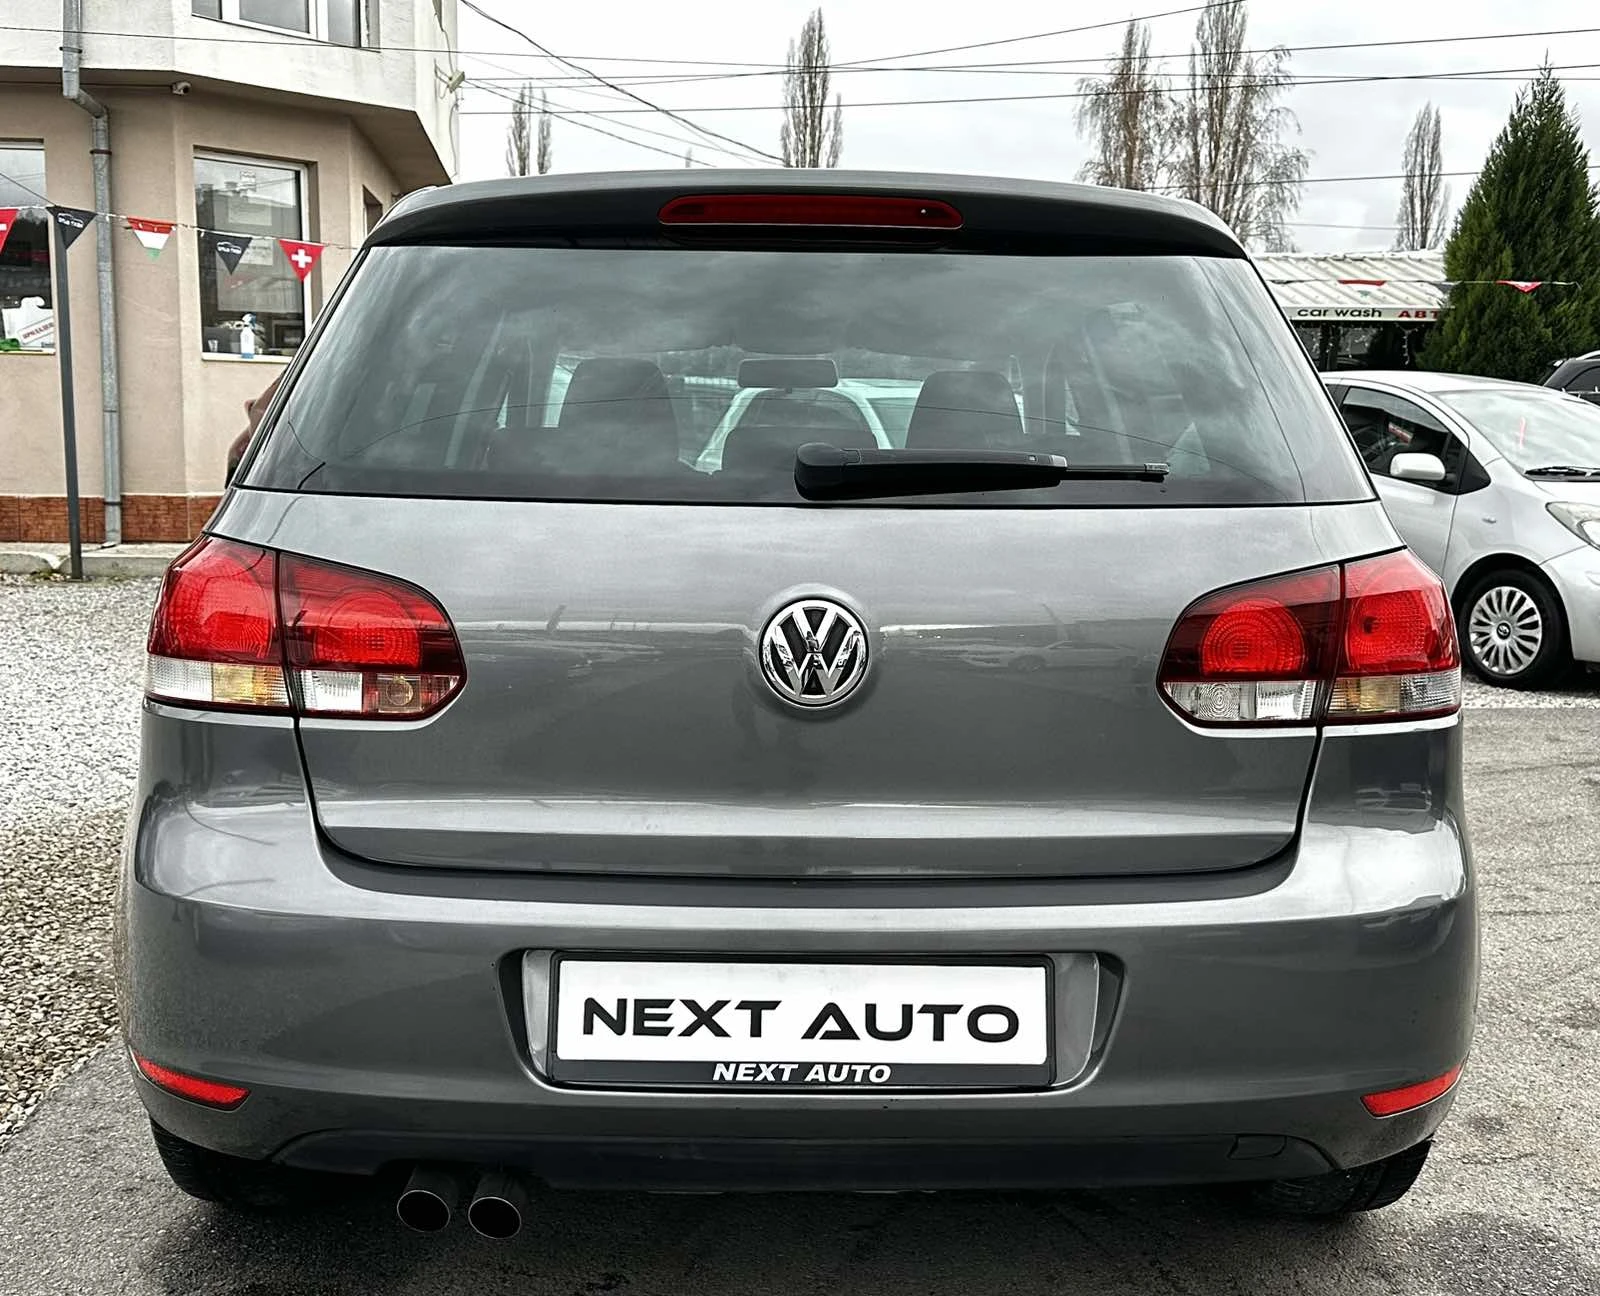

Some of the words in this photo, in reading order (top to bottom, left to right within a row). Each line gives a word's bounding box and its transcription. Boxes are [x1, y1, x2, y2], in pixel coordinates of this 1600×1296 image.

[1297, 308, 1329, 317] car
[1335, 307, 1382, 318] wash
[582, 997, 783, 1038] NEXT
[800, 1002, 1020, 1043] AUTO
[712, 1063, 800, 1083] NEXT
[805, 1064, 893, 1083] AUTO
